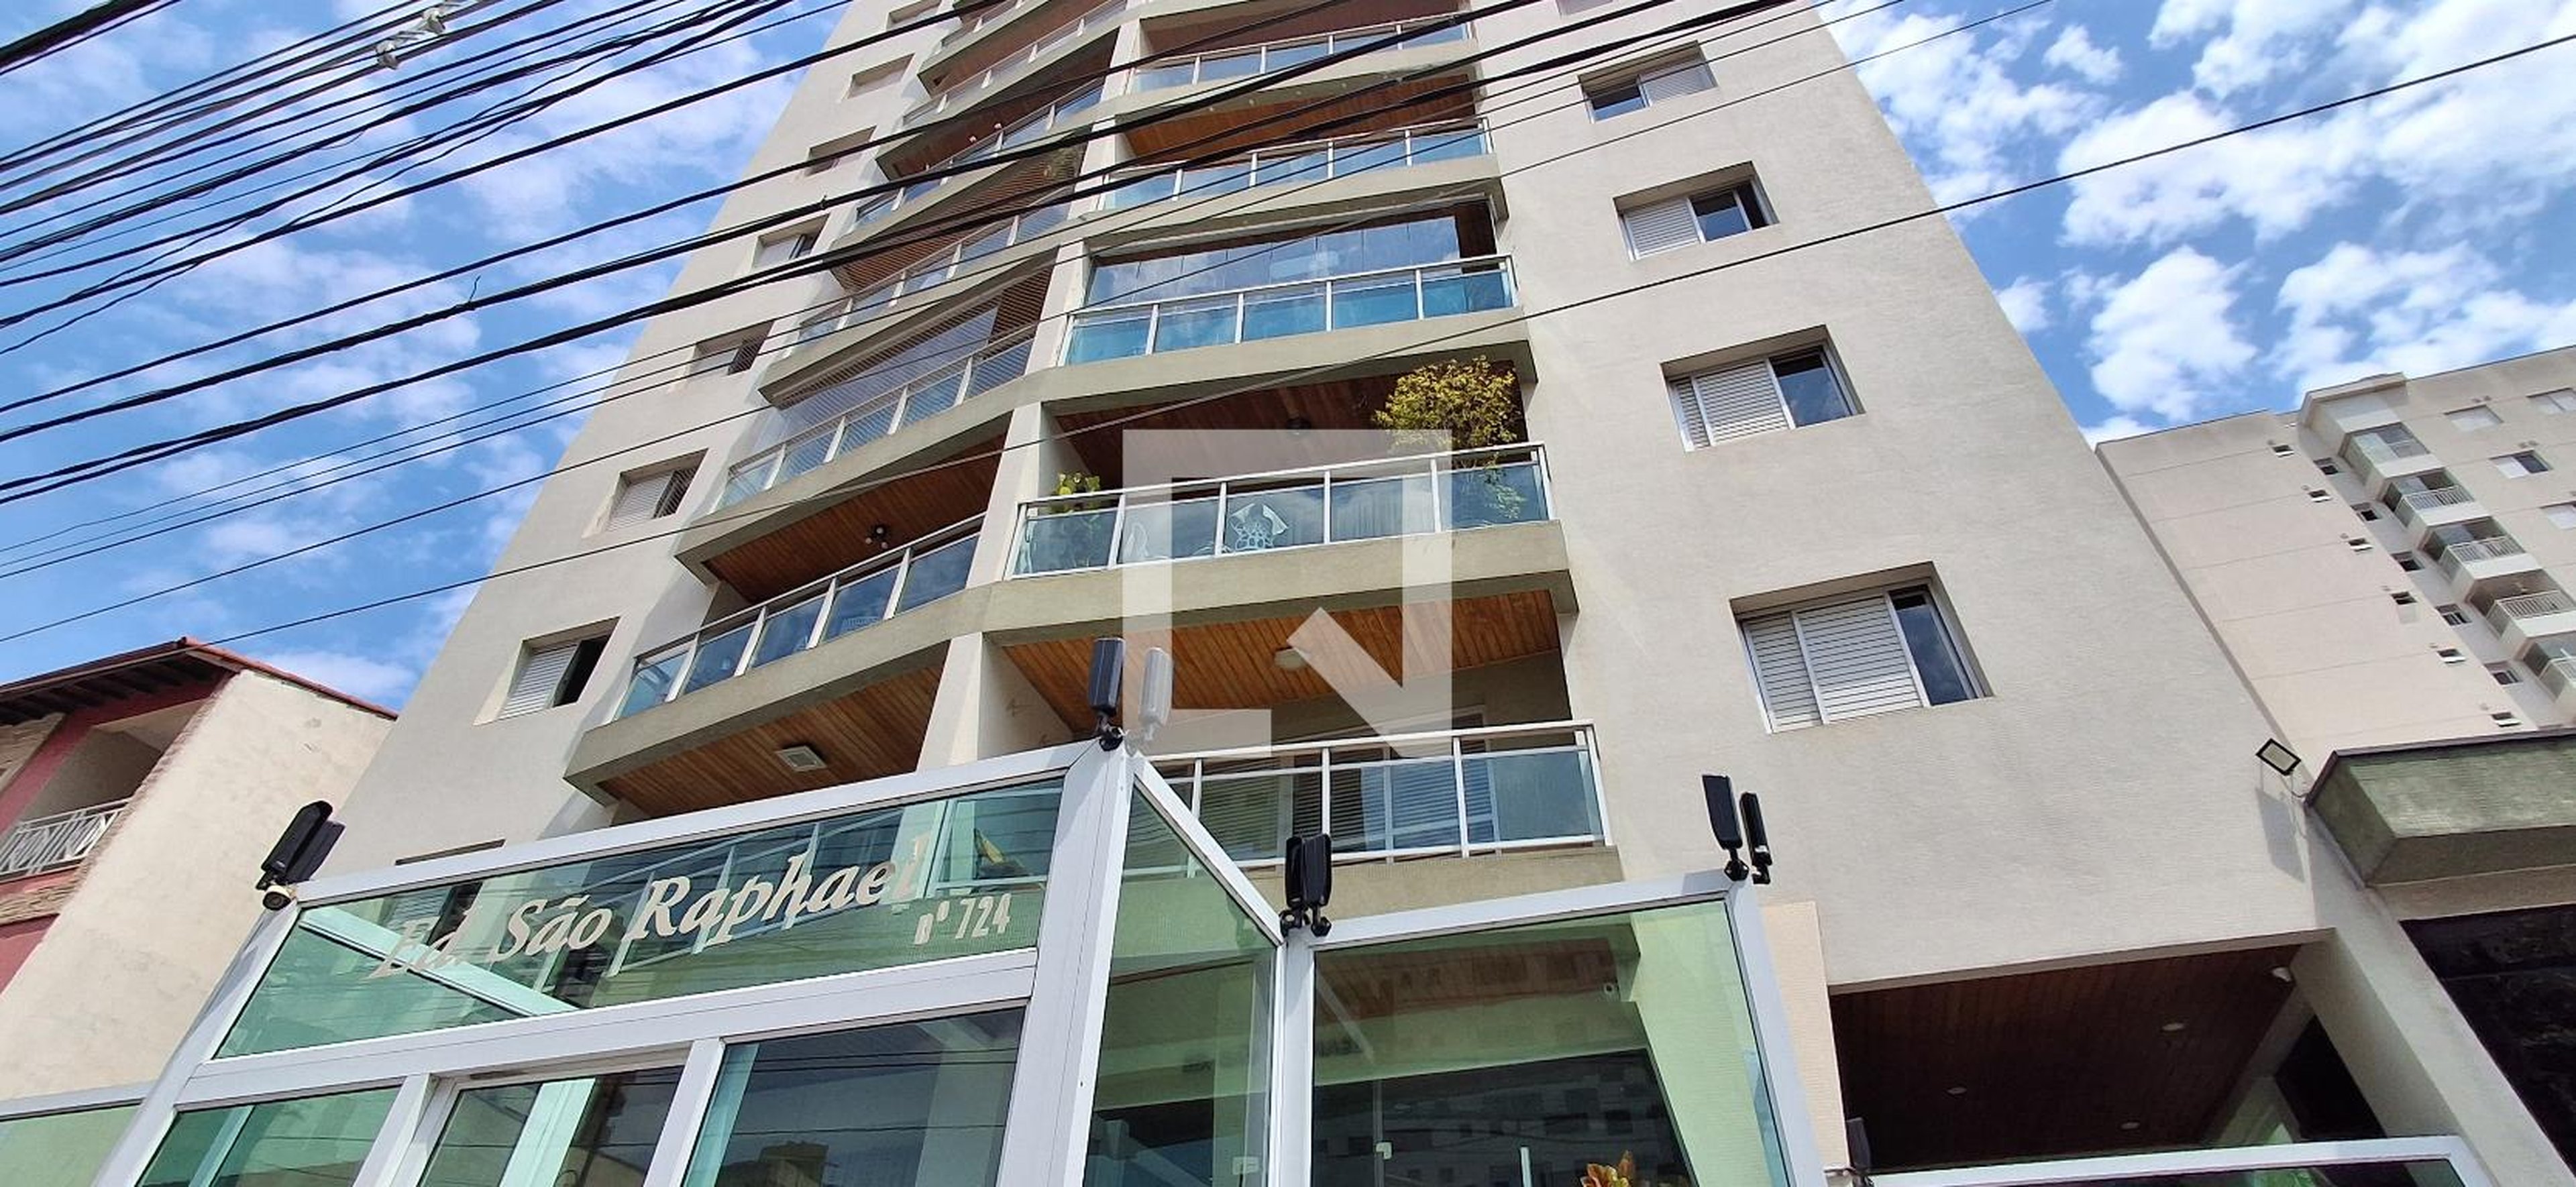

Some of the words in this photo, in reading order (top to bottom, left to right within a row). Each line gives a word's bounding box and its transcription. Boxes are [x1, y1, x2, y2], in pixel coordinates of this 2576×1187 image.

[486, 895, 612, 962] São
[623, 833, 930, 946] Raphael
[955, 893, 1012, 939] 724
